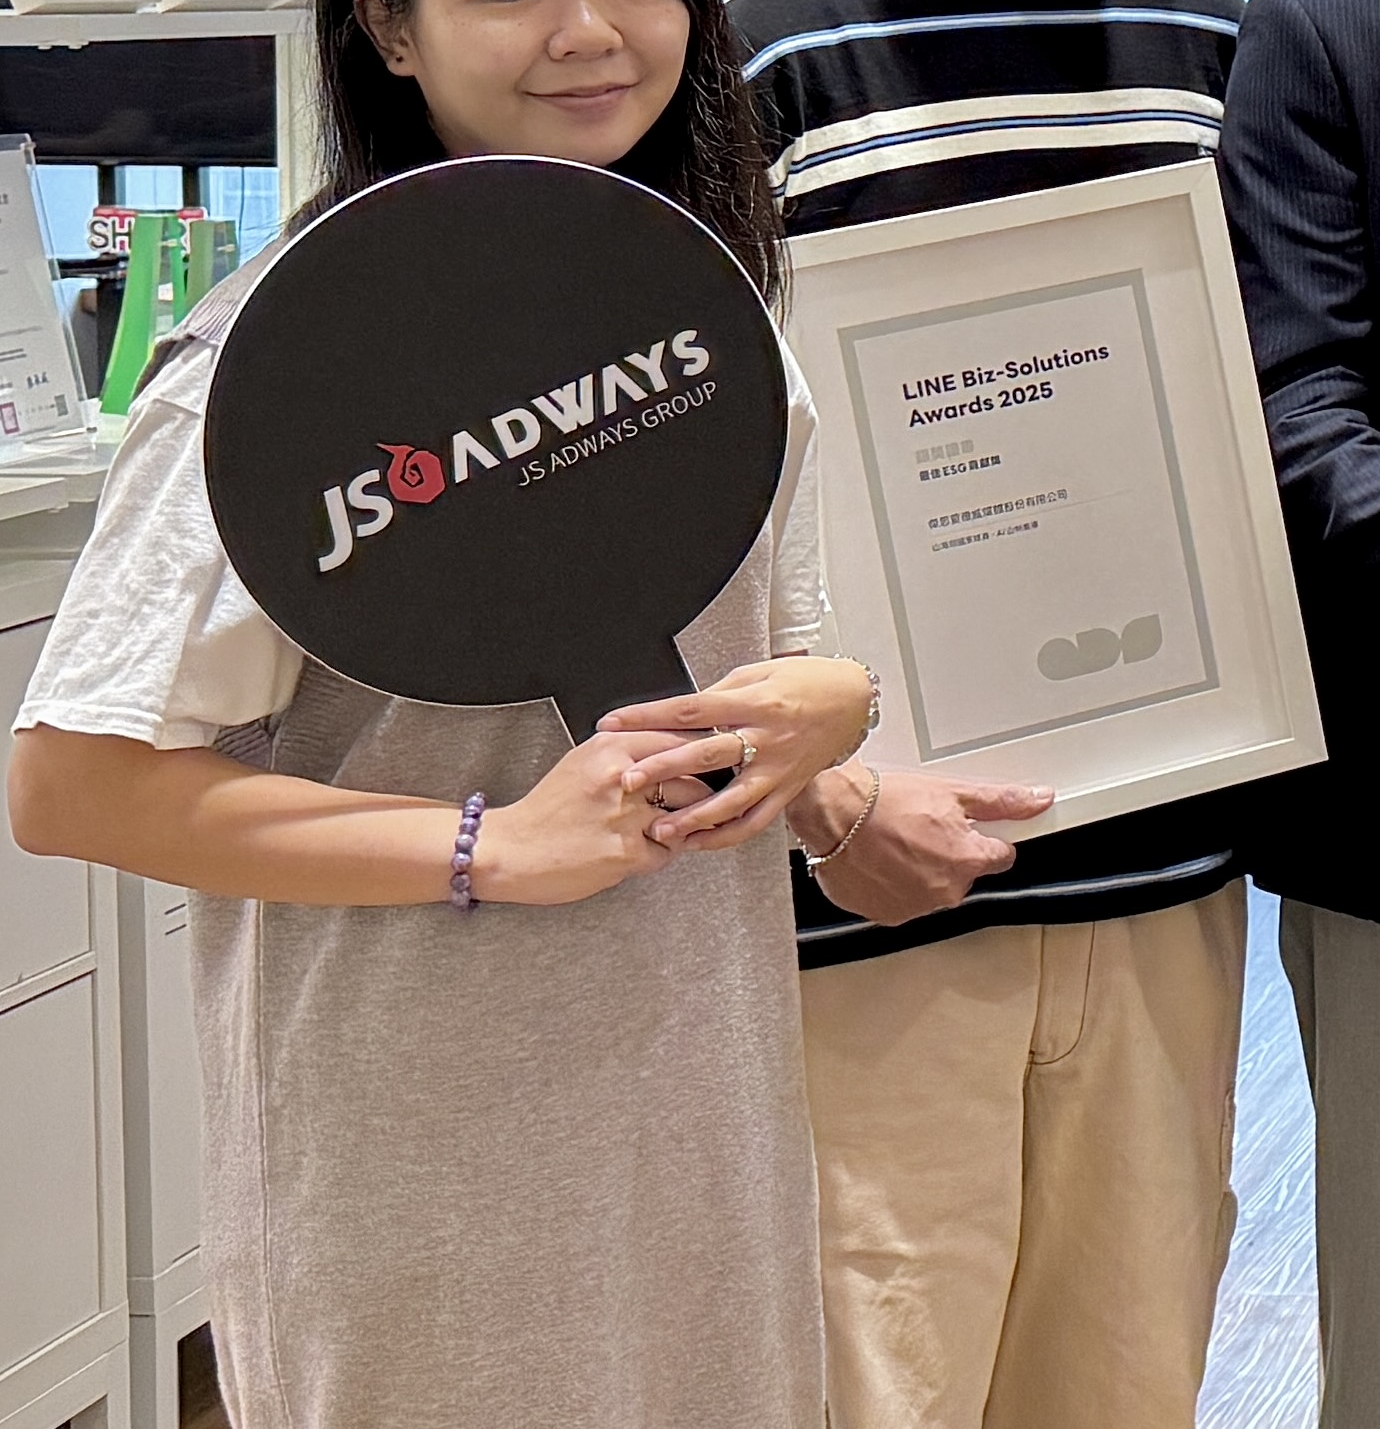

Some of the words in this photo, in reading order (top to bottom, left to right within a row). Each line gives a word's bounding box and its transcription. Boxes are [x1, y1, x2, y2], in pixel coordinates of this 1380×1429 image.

[902, 374, 957, 400] LINE
[962, 346, 1110, 389] Biz-Solutions
[909, 395, 994, 427] Awards
[998, 381, 1054, 409] 2025
[518, 462, 546, 487] JS
[551, 417, 638, 473] ADWAYS
[641, 381, 718, 429] GROUP
